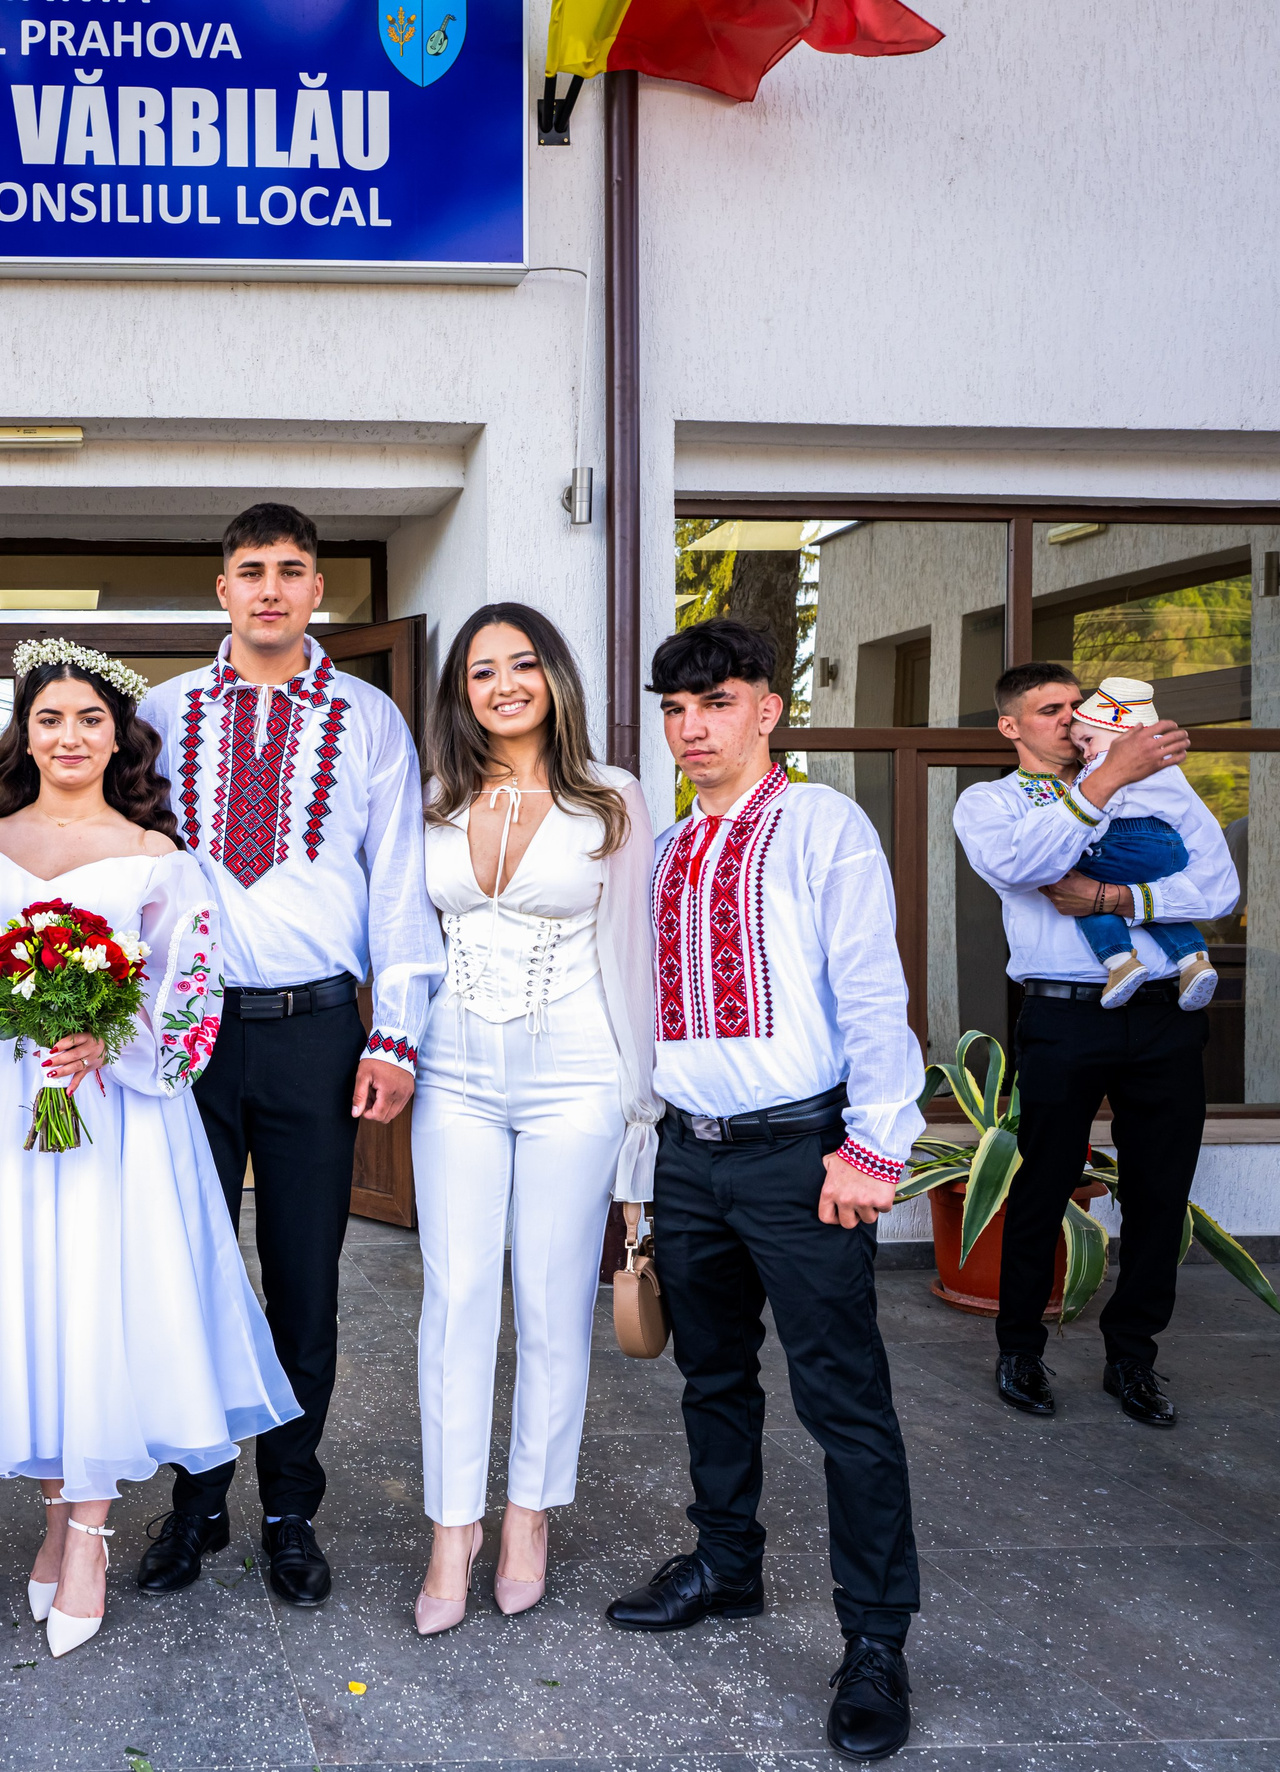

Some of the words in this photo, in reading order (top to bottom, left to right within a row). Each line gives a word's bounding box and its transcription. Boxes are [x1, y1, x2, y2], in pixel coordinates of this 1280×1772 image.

[20, 19, 242, 59] PRAHOVA
[10, 68, 390, 171] VĂRBILĂU
[236, 185, 392, 227] LOCAL
